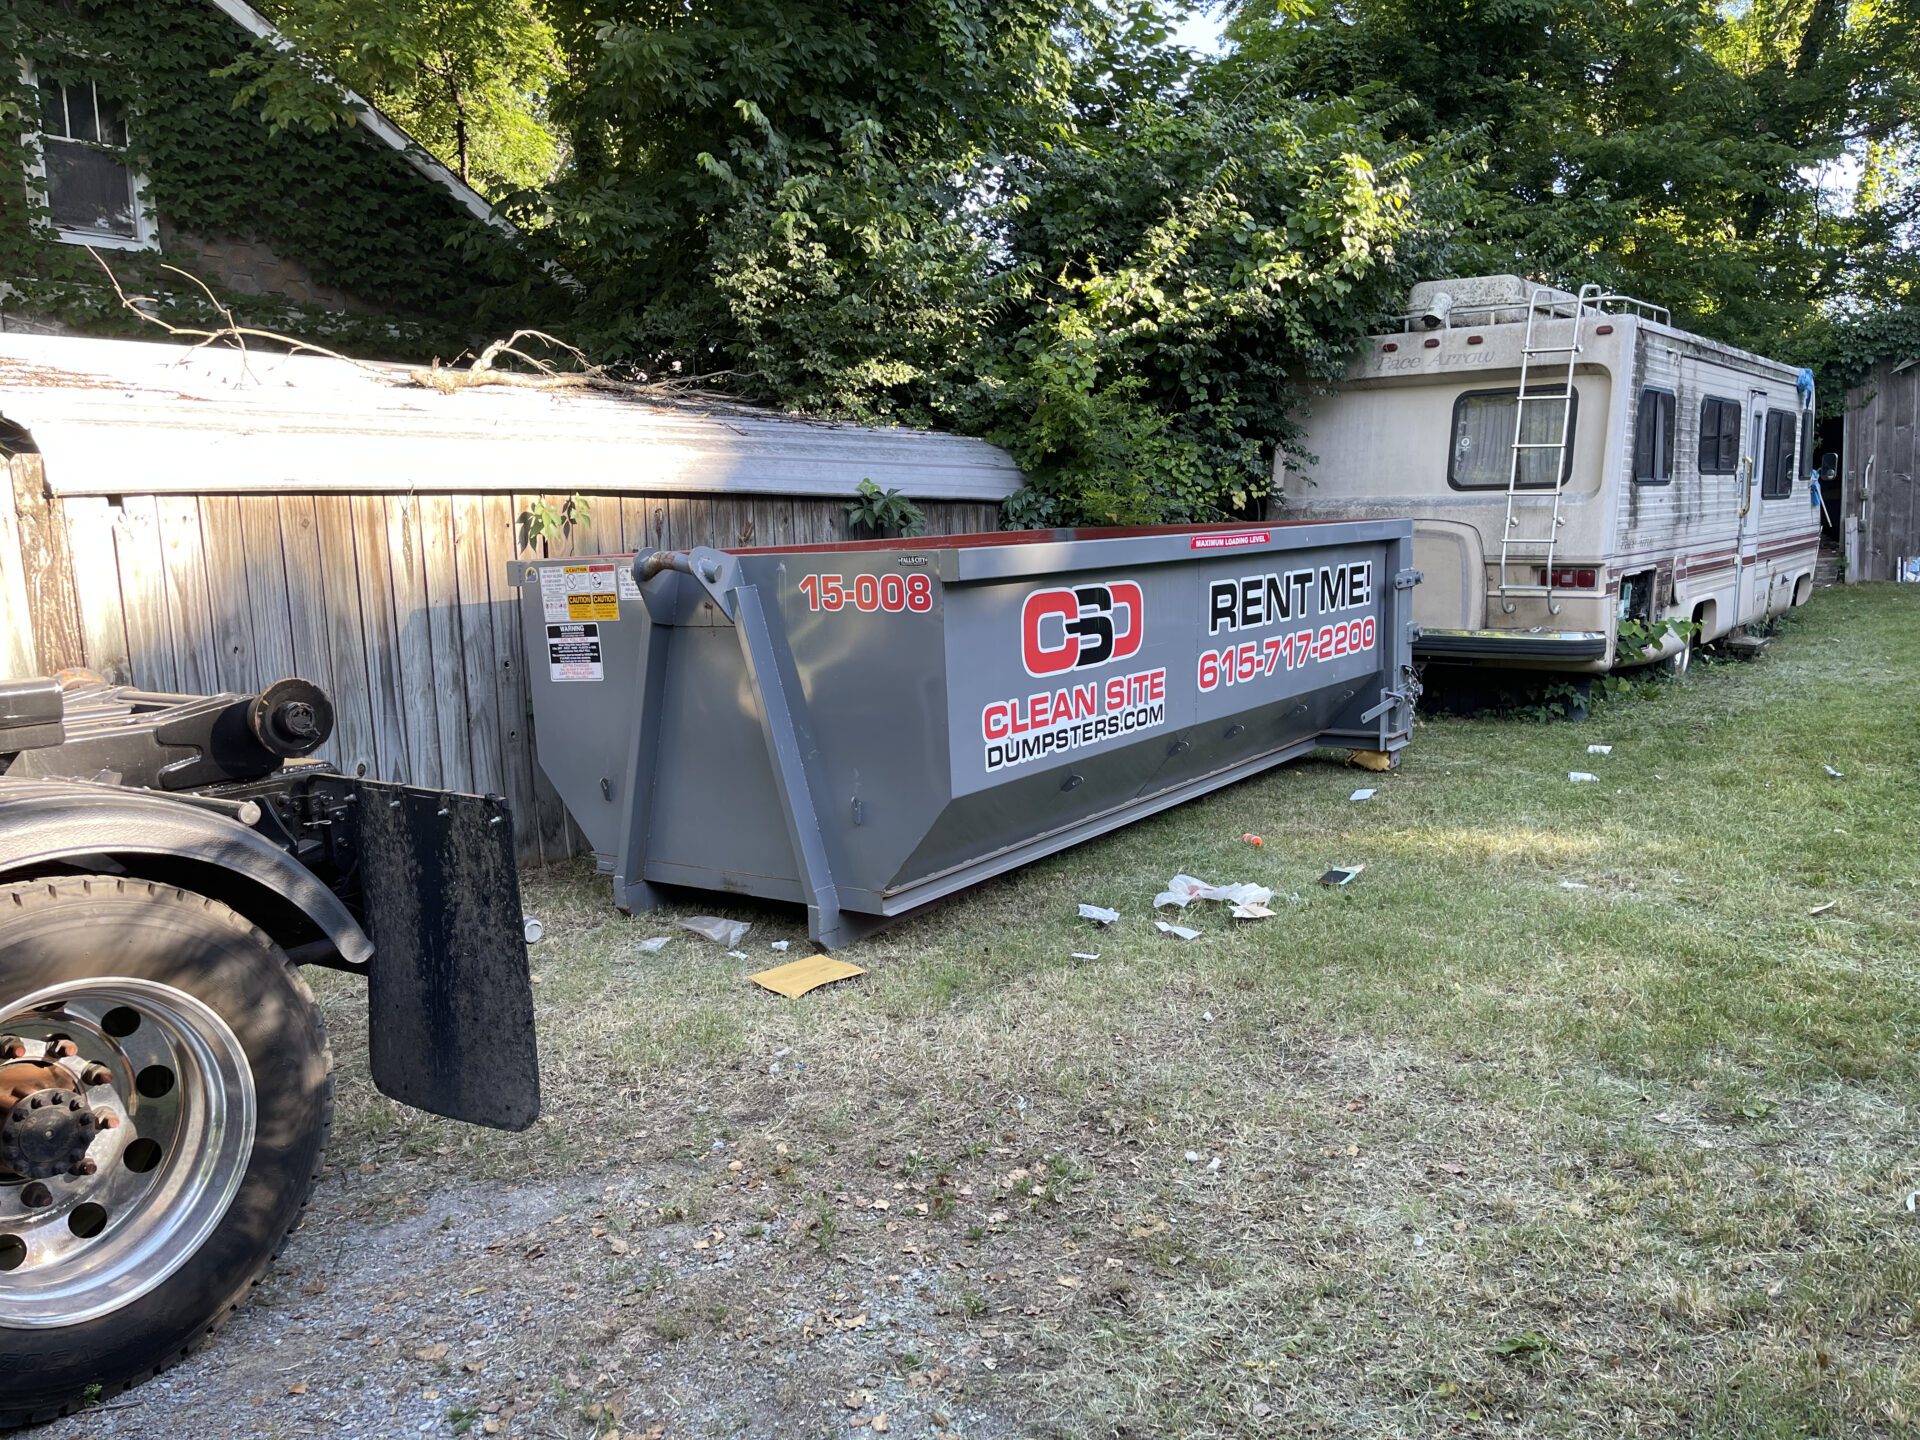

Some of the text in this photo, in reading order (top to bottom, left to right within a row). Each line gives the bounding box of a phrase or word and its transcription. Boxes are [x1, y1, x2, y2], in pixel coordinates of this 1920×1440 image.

[1428, 351, 1494, 366] Arrow
[1196, 539, 1224, 547] MAXIMUM
[1225, 537, 1248, 545] LOADING
[593, 595, 616, 603] CAUTION
[799, 574, 932, 612] 15-008
[1209, 562, 1371, 634] RENT ME!
[1198, 616, 1375, 691] 615-717-2200
[983, 668, 1165, 741] CLEAN SITE
[986, 702, 1165, 771] DUMPSTERS.COM
